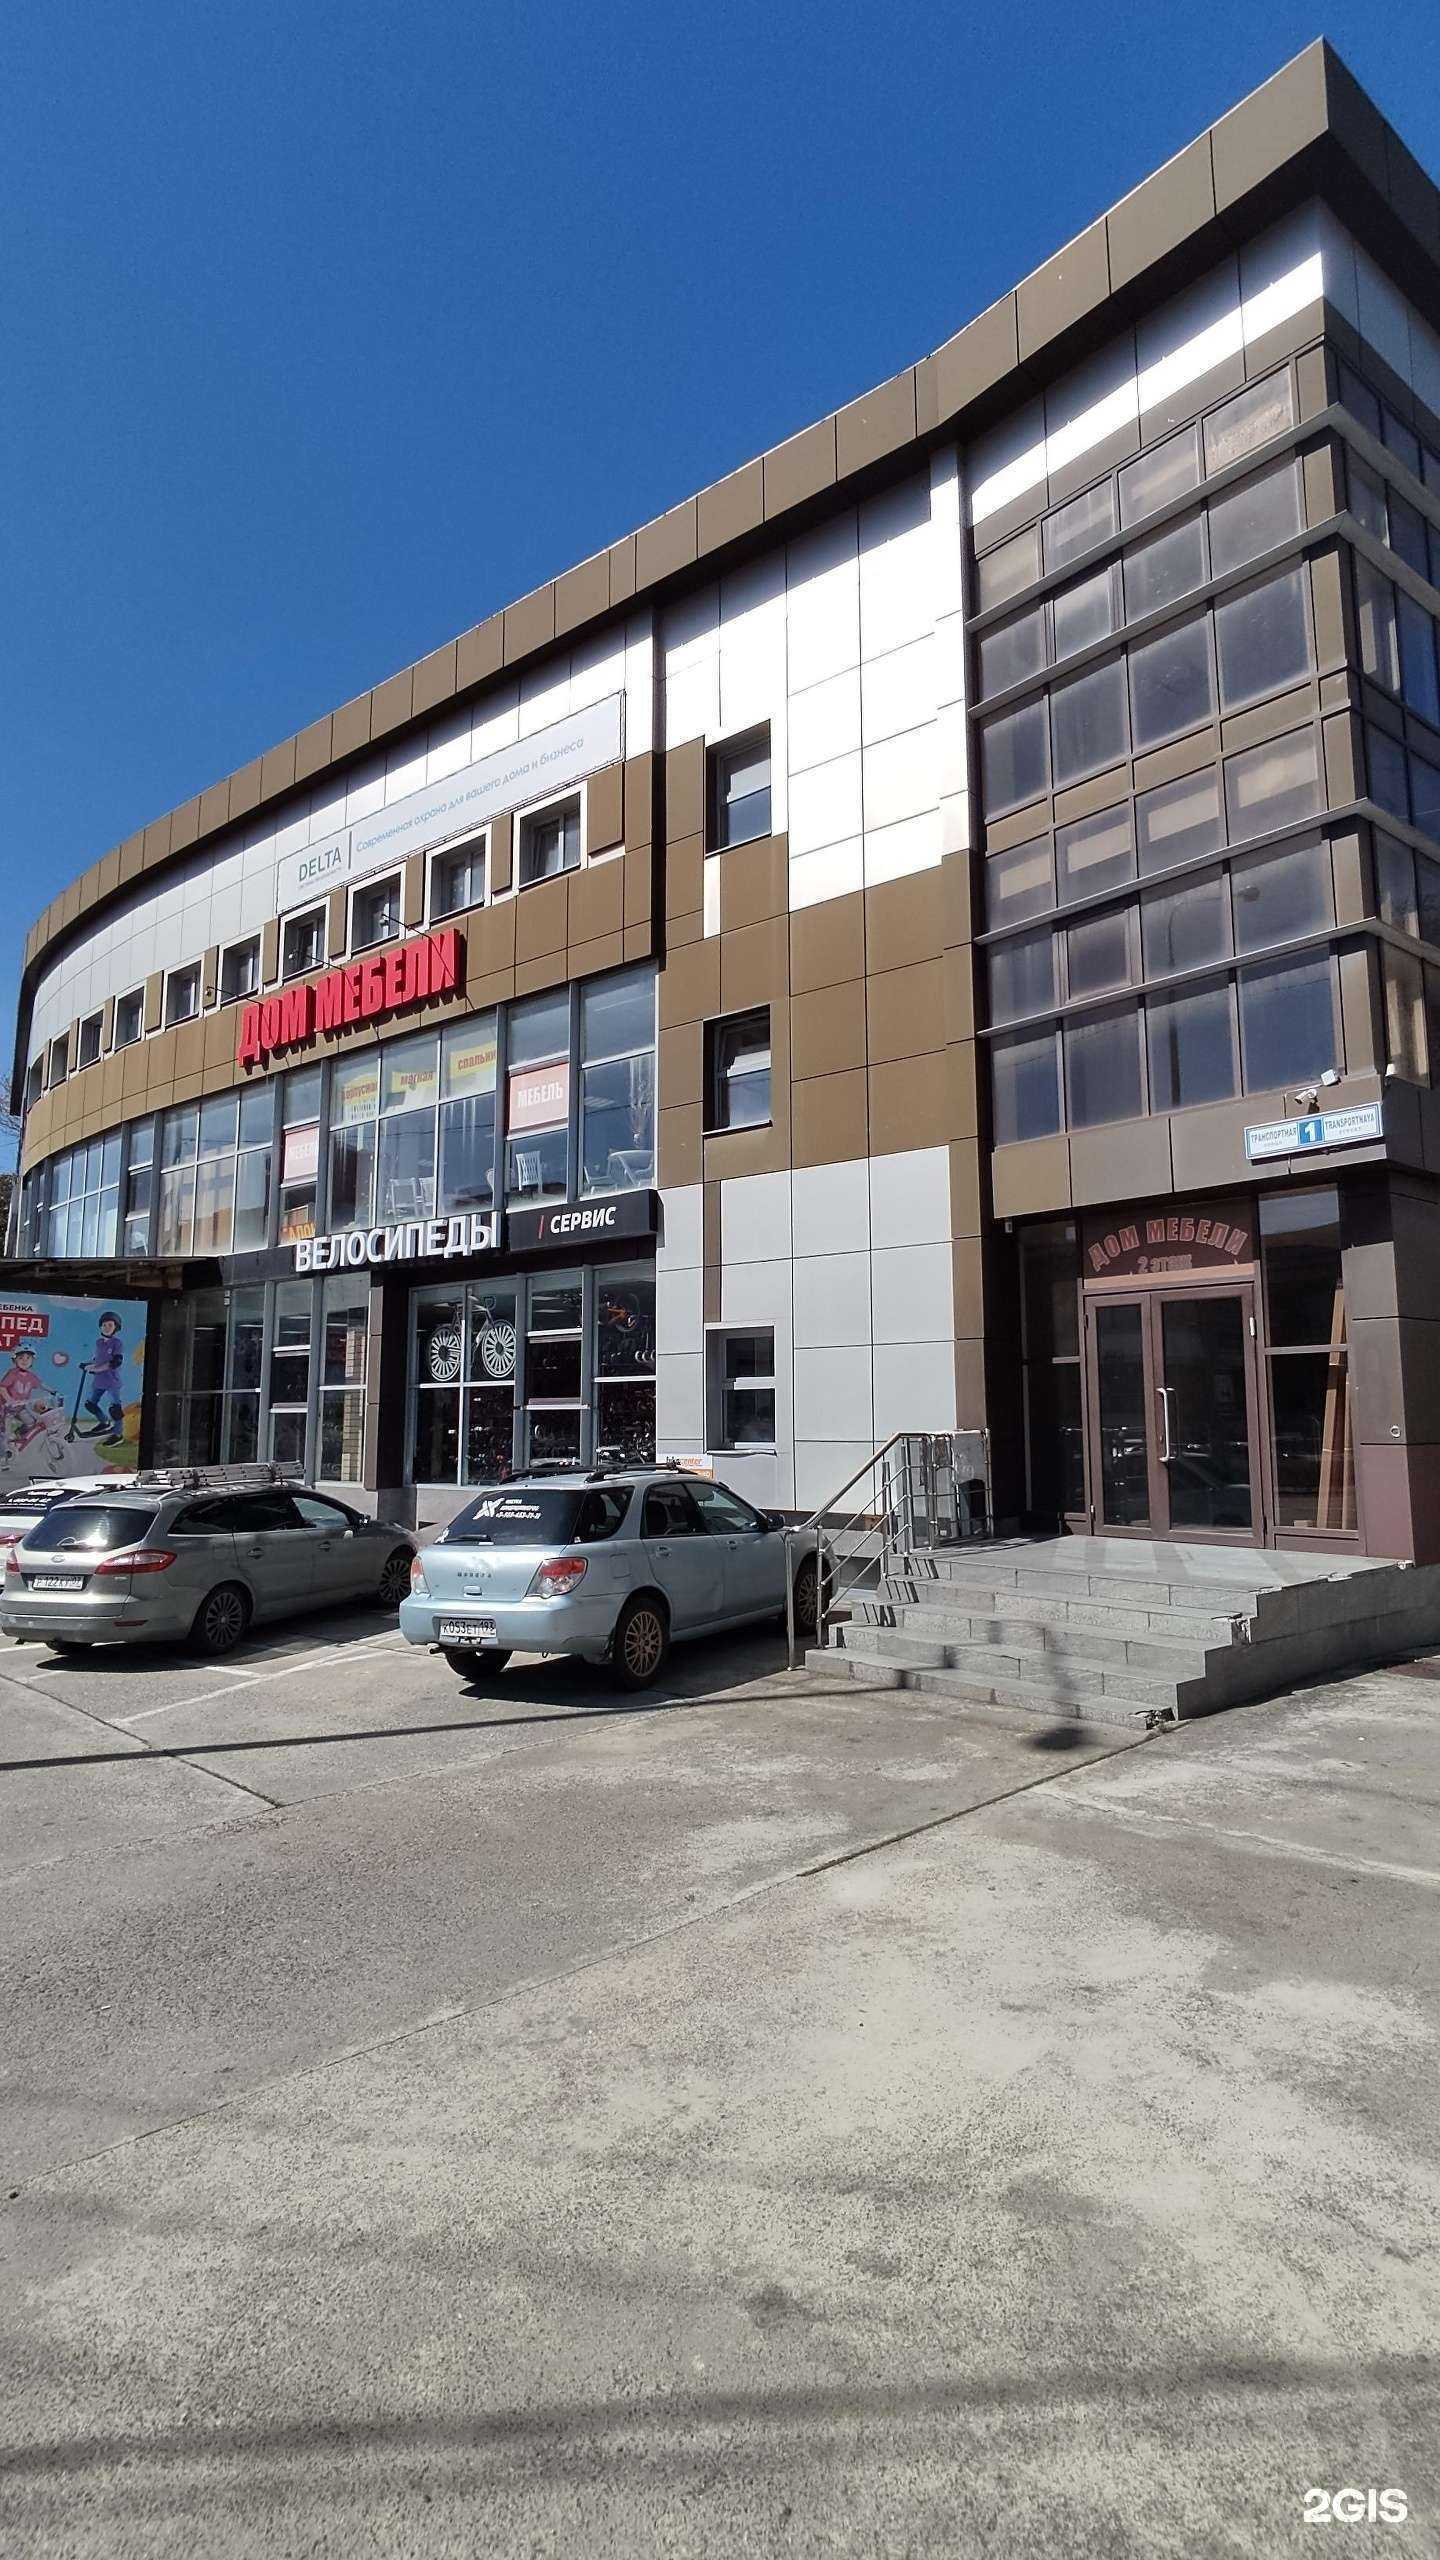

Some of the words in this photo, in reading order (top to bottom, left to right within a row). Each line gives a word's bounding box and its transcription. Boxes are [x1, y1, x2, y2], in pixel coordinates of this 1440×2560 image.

[447, 796, 464, 811] для
[502, 763, 530, 785] дома
[299, 846, 342, 882] DELTA
[237, 984, 308, 1067] ДОМ
[314, 928, 459, 1033] МЕБЕЛИ
[517, 1081, 564, 1109] МЕБЕЛЬ
[1304, 1121, 1316, 1142] 1
[550, 1206, 617, 1235] СЕРВИС
[295, 1211, 500, 1272] ВЕЛОСИПЕДЫ
[1088, 1225, 1140, 1272] ДОМ
[1146, 1217, 1249, 1256] МЕБЕЛИ
[1137, 1255, 1149, 1273] 2
